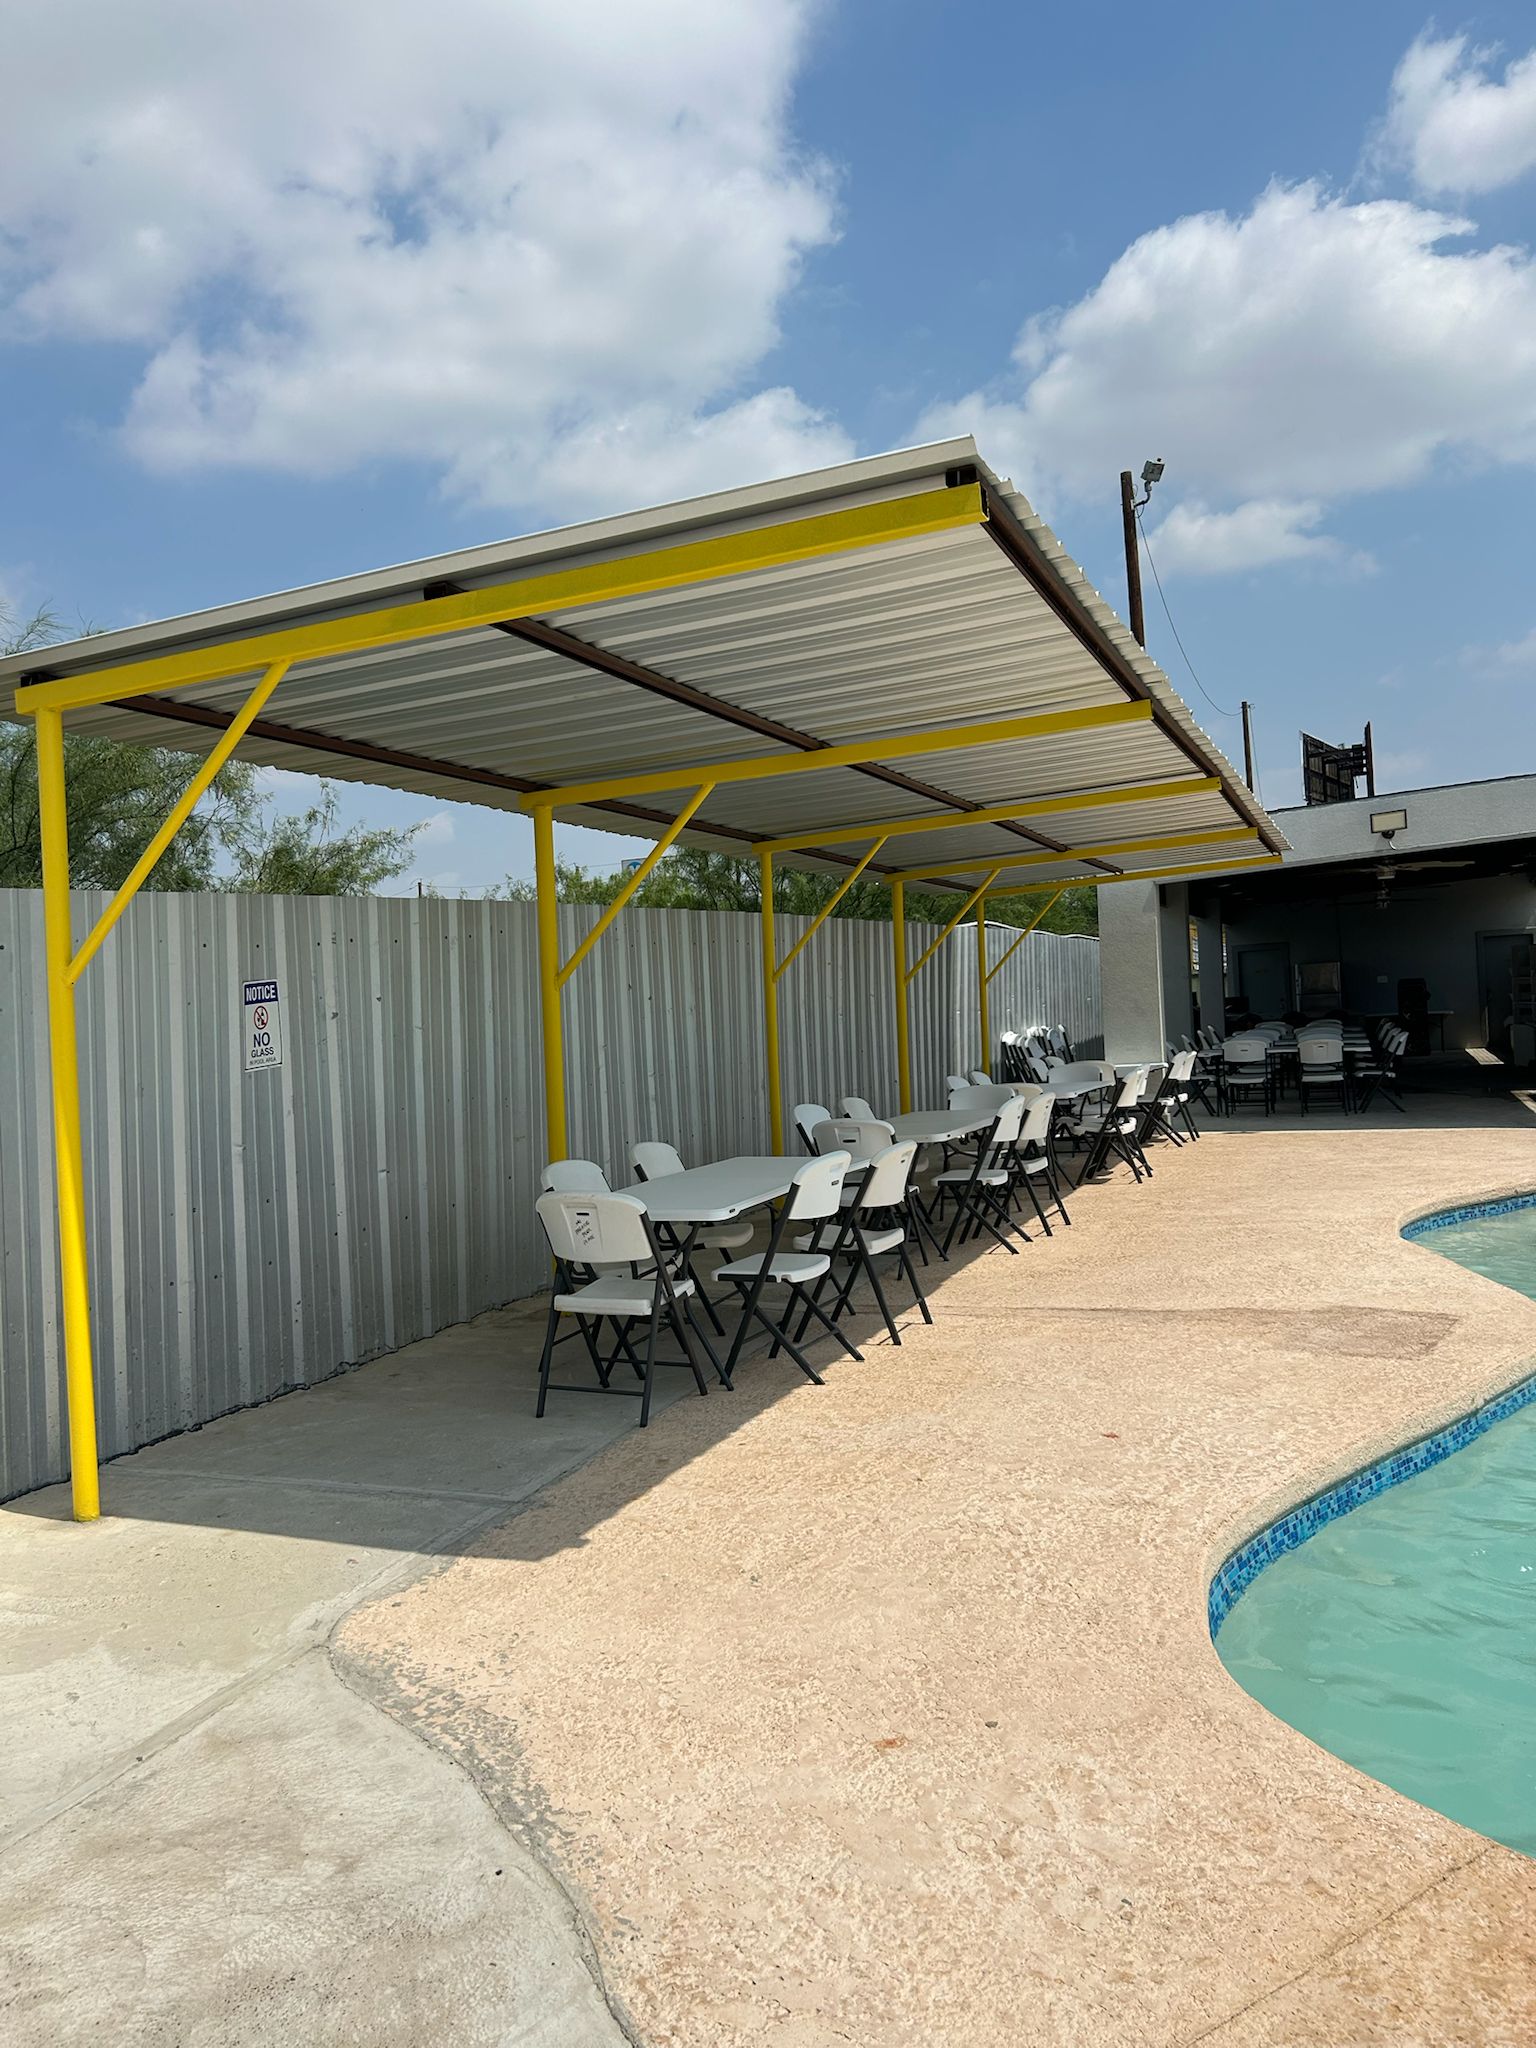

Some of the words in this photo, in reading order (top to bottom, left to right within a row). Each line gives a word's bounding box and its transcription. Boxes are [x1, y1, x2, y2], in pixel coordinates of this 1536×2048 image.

[246, 985, 276, 1002] NOTICE
[253, 1032, 271, 1048] NO
[251, 1047, 274, 1058] GLASS
